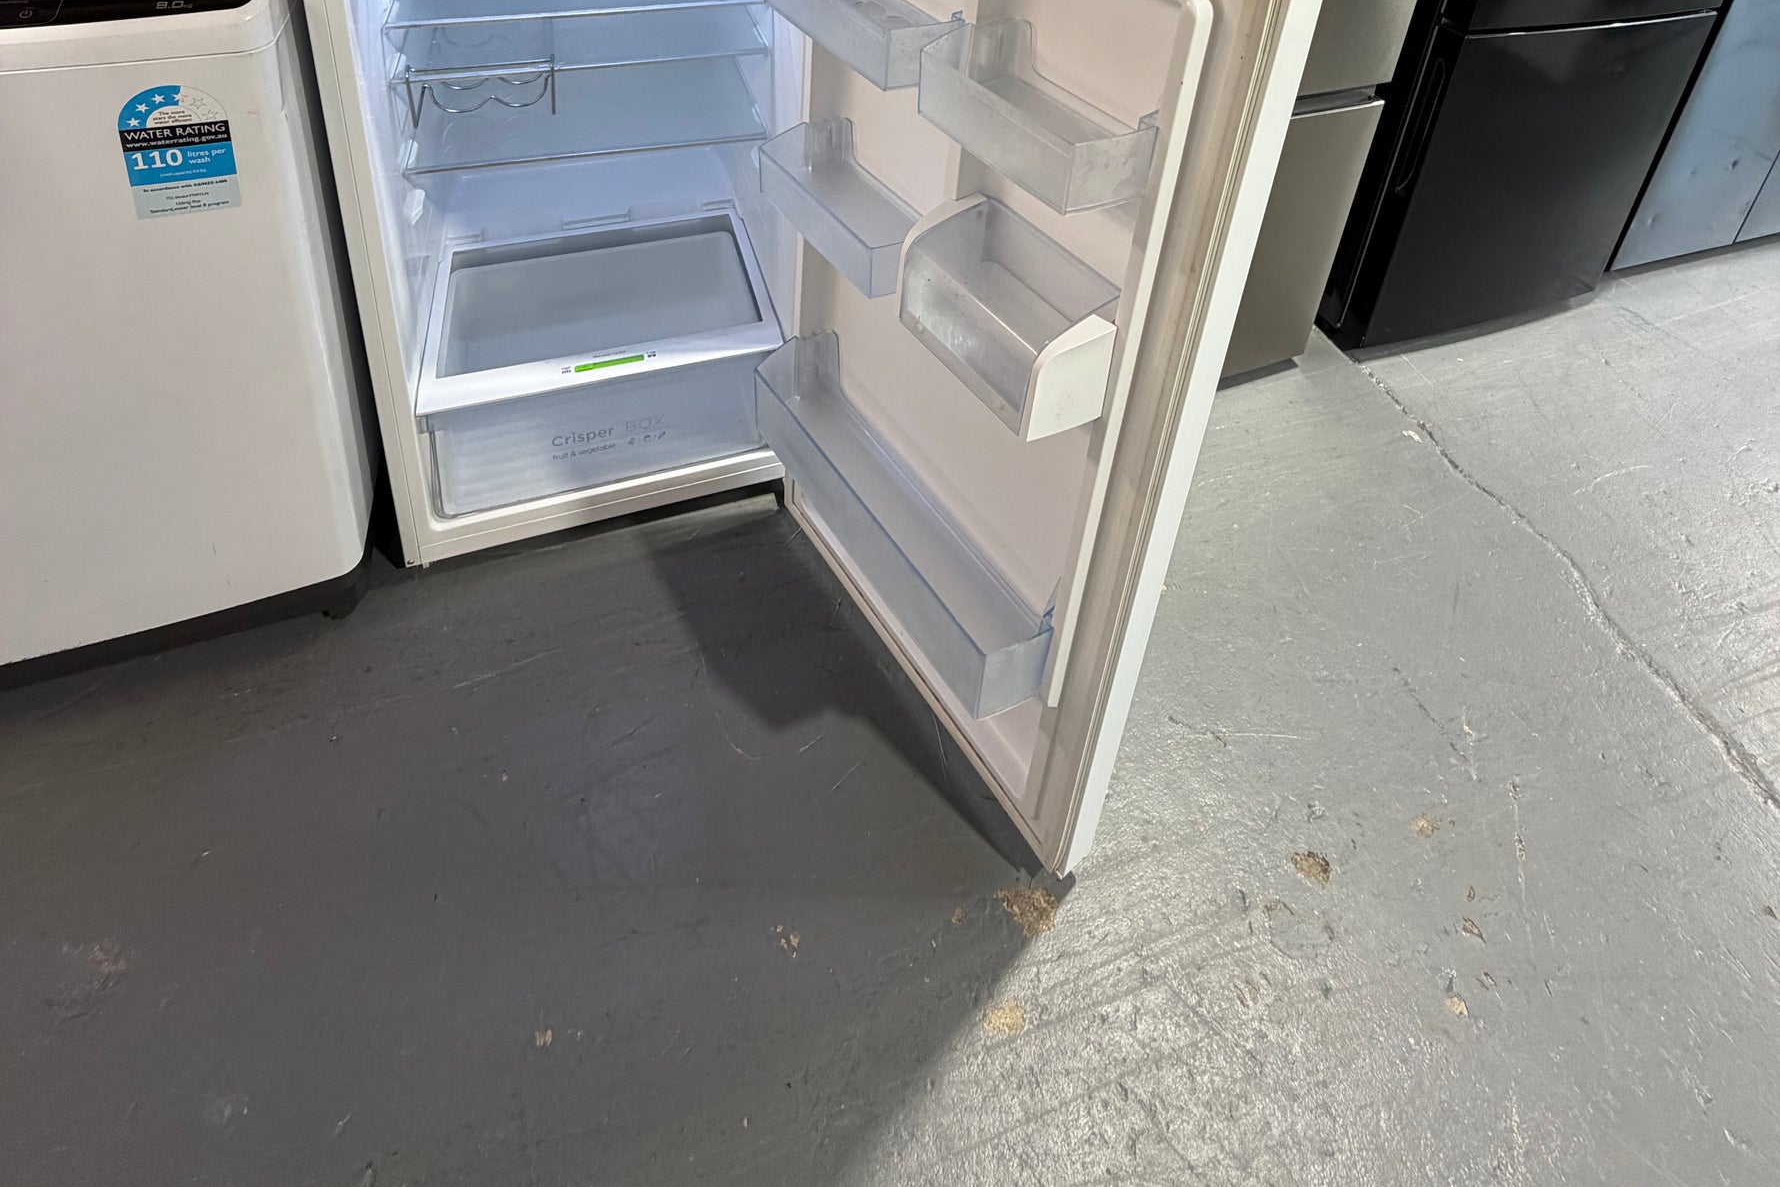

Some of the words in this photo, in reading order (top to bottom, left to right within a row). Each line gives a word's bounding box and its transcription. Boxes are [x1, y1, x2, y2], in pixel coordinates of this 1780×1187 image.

[124, 127, 173, 141] WATER
[175, 122, 226, 136] RATING
[126, 133, 228, 148] www.waterrating.gov.au
[131, 149, 183, 171] 110
[187, 150, 209, 158] litres
[211, 148, 227, 156] per
[188, 156, 211, 164] wash
[551, 426, 616, 447] Crisper
[624, 414, 665, 433] BOX
[552, 452, 569, 461] fruit
[570, 450, 577, 458] &
